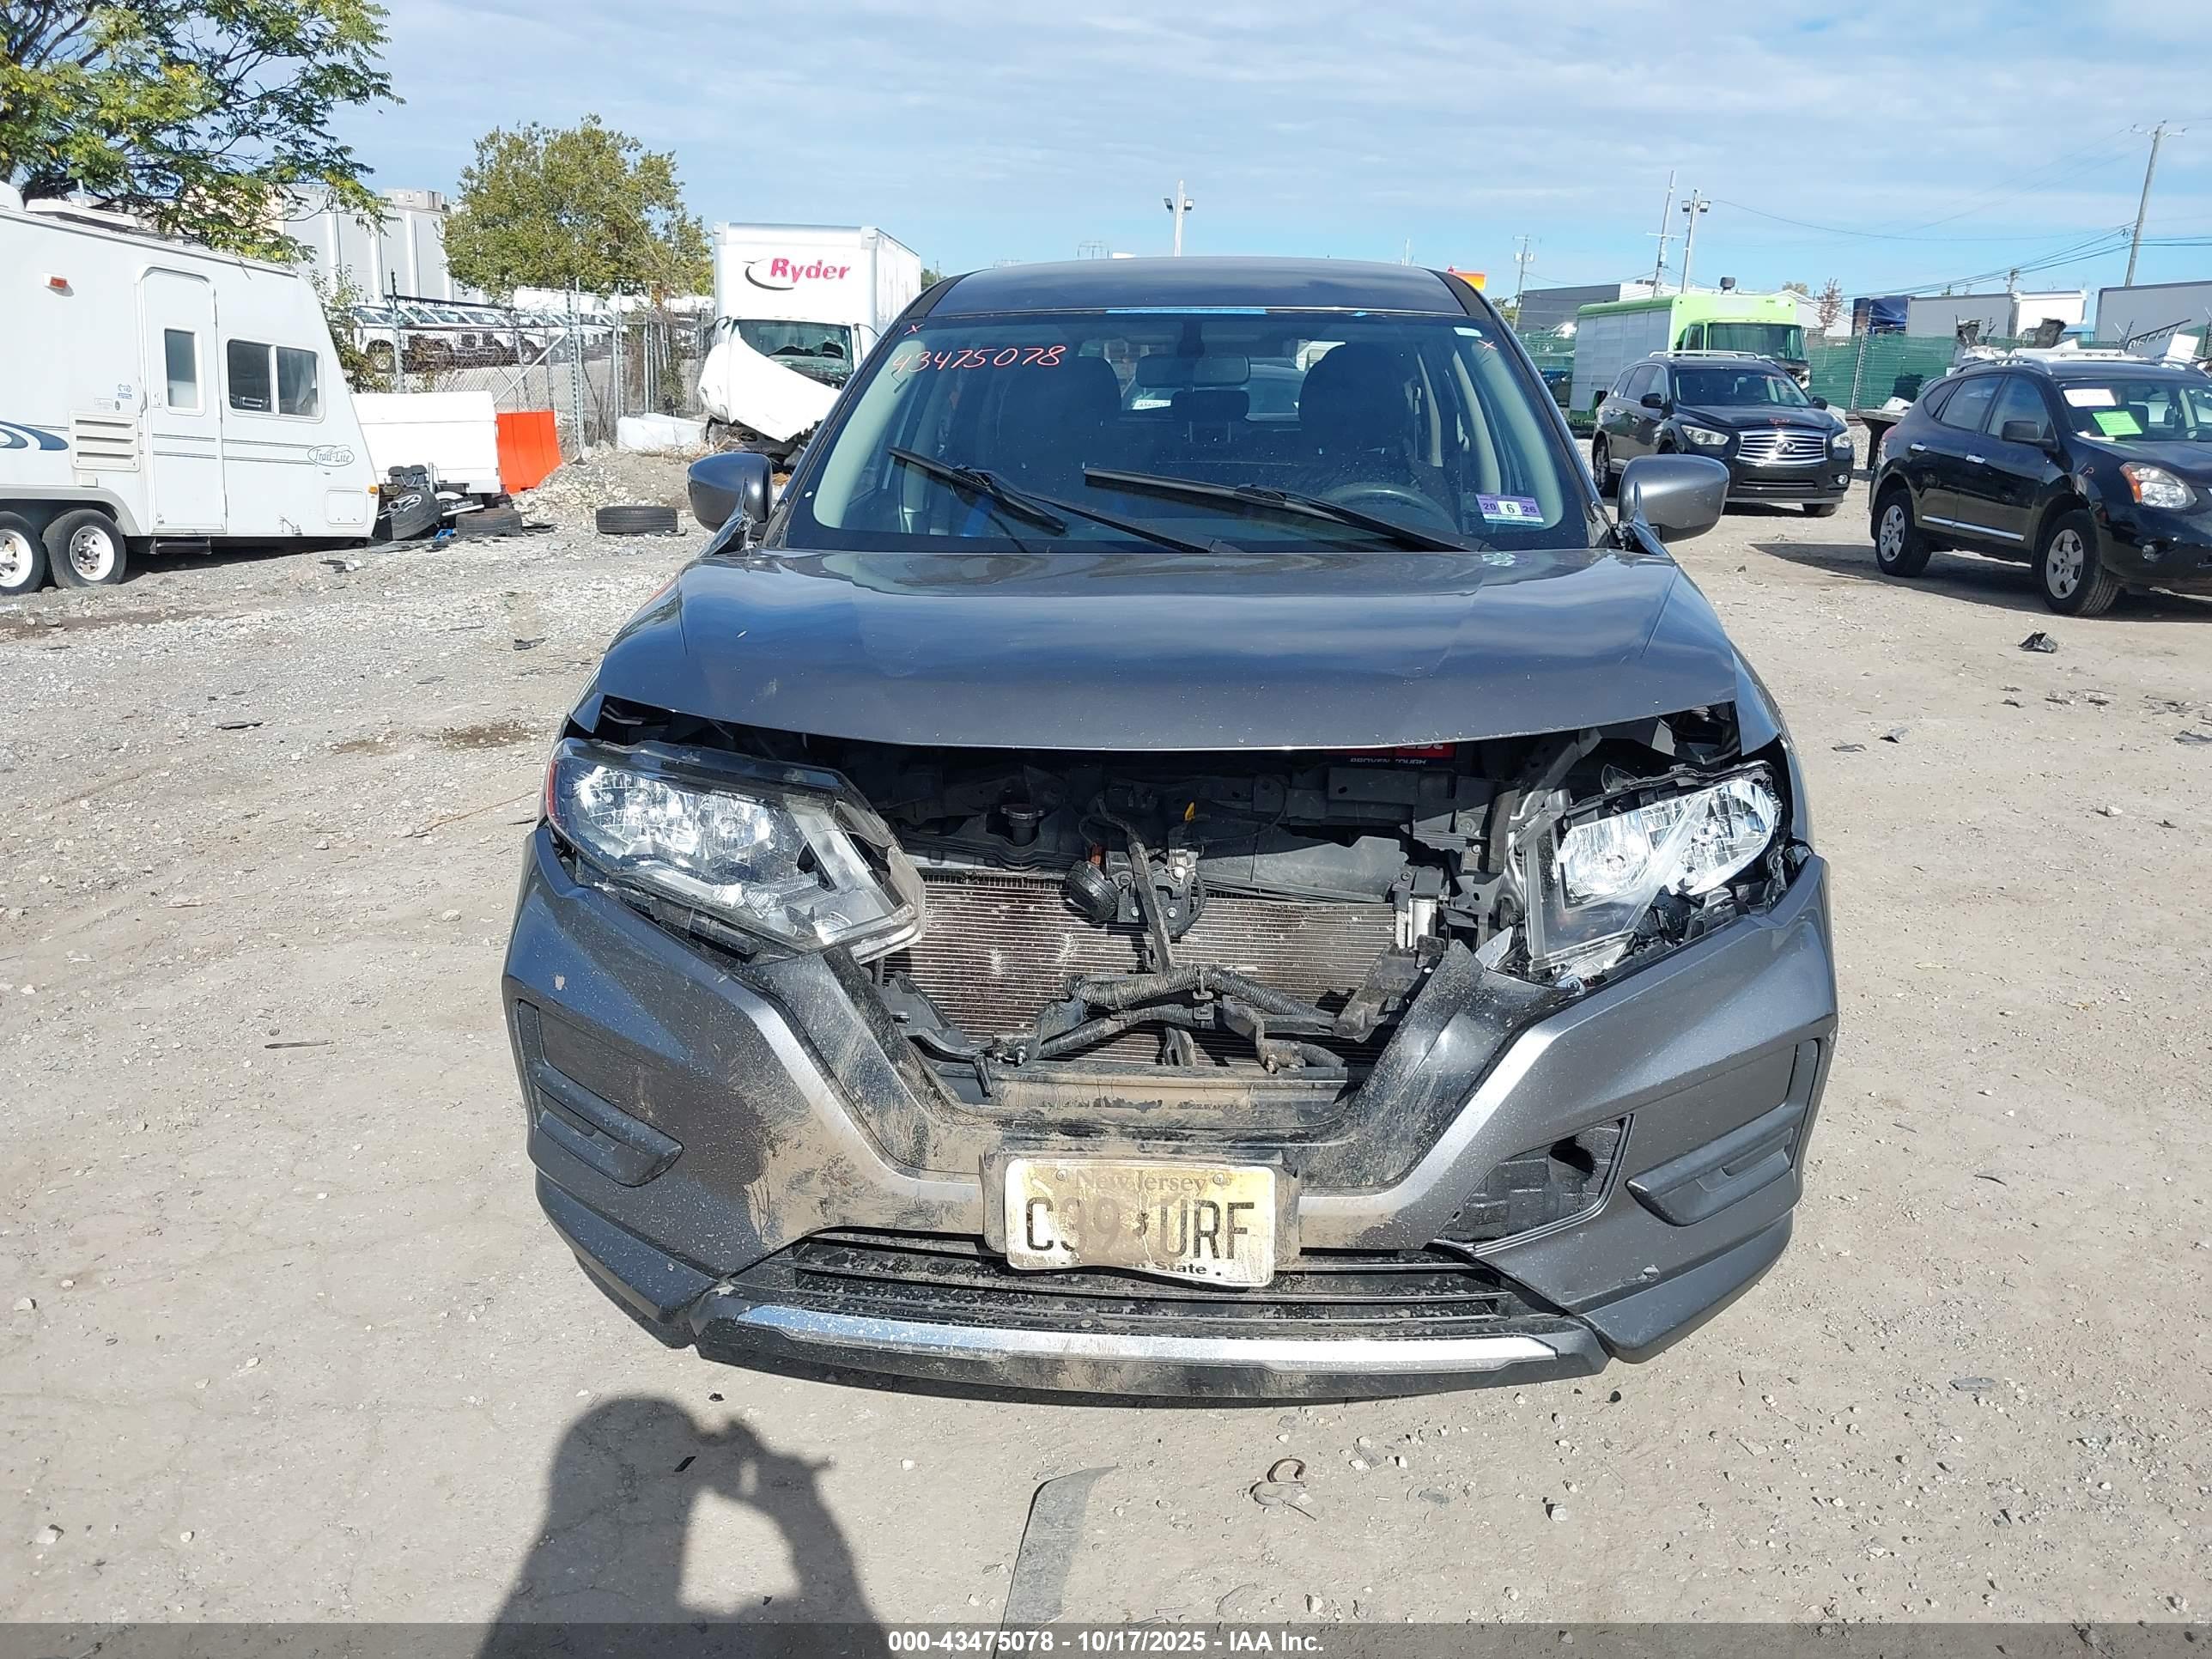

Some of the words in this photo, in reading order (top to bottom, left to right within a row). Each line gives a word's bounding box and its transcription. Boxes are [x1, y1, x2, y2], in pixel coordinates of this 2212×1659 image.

[770, 258, 851, 283] Ryder
[892, 345, 1066, 373] 43475078
[1483, 502, 1497, 511] 20
[1506, 503, 1516, 514] 6
[1522, 505, 1537, 514] 26
[1074, 1170, 1131, 1190] New
[1135, 1170, 1206, 1193] Jersey
[1159, 1199, 1255, 1260] URF
